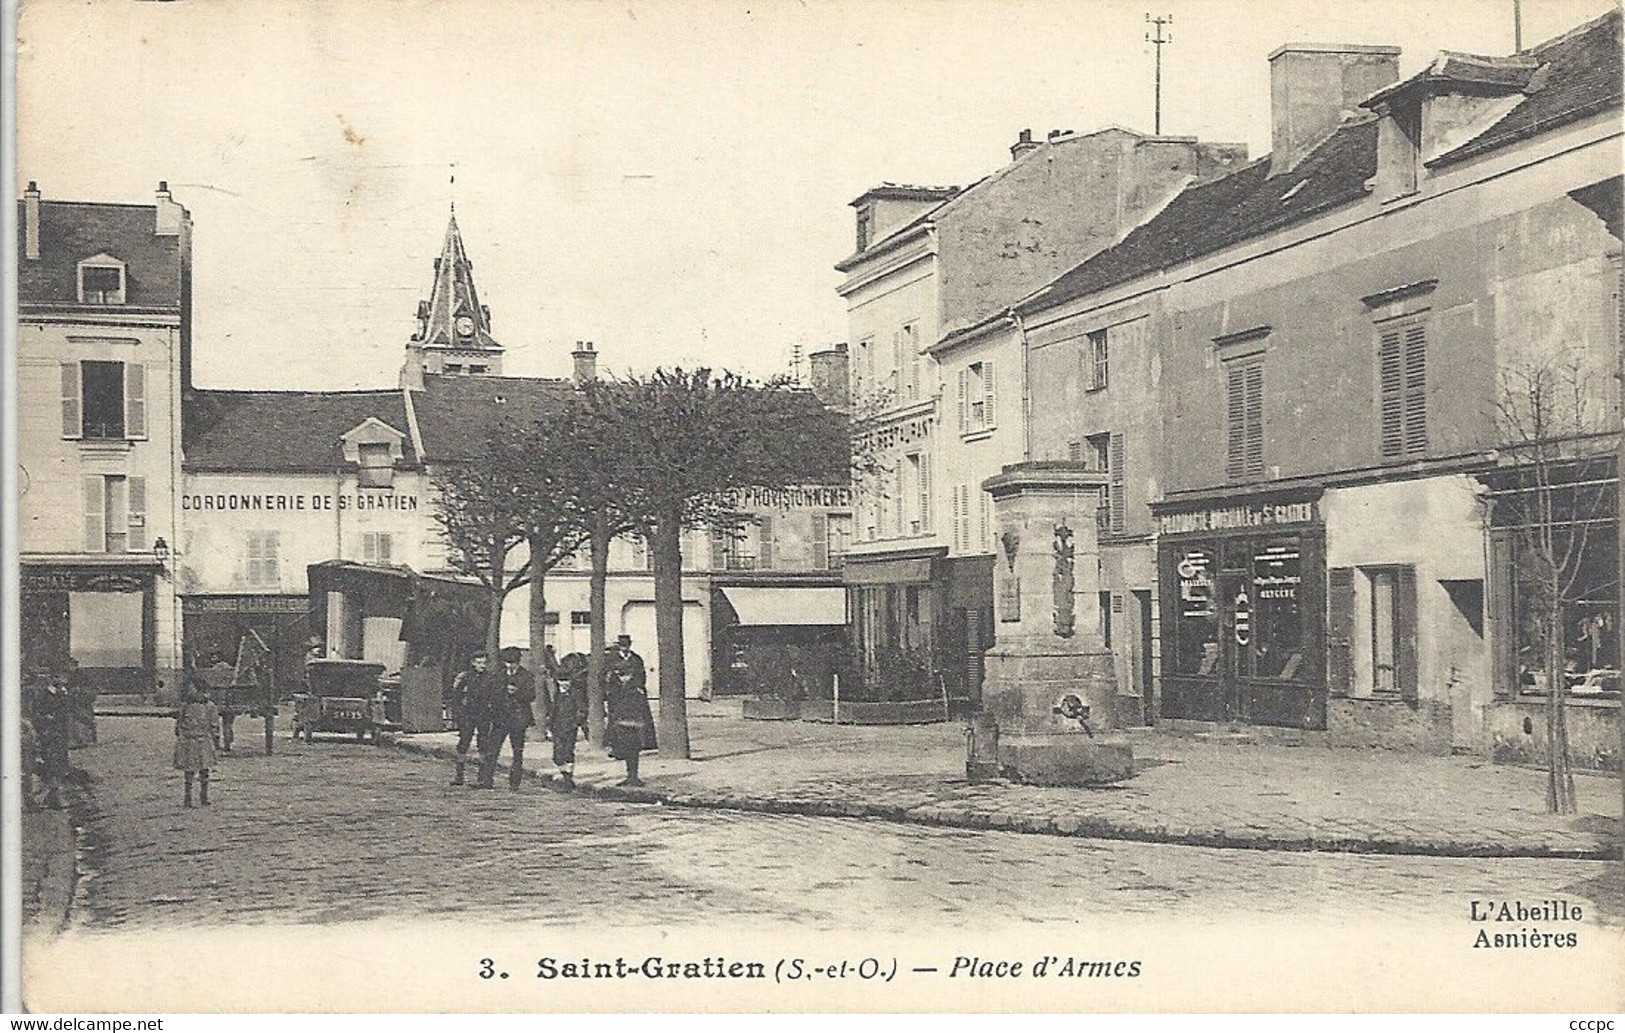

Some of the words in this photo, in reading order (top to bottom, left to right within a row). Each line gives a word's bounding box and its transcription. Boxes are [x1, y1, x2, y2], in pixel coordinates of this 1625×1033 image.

[182, 494, 305, 510] CORDONNERIE
[312, 494, 332, 510] DE
[357, 494, 418, 510] GRATIEN
